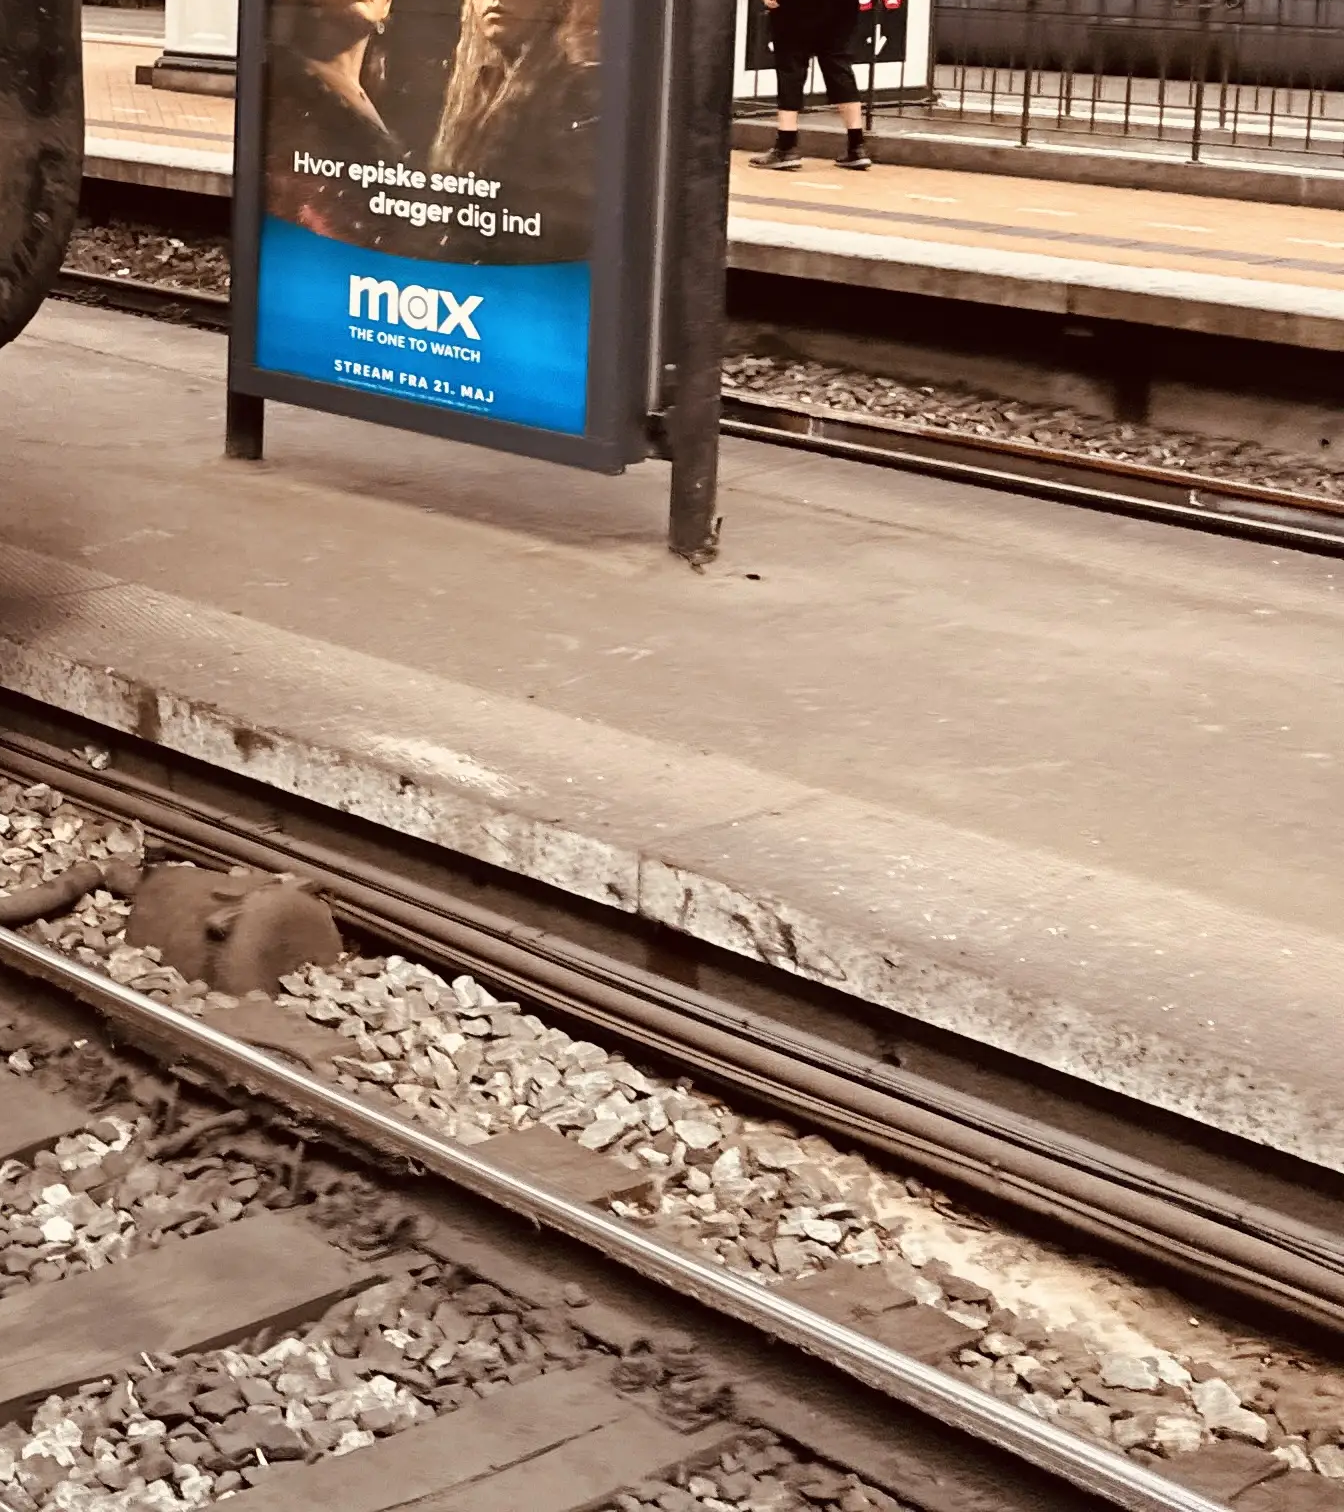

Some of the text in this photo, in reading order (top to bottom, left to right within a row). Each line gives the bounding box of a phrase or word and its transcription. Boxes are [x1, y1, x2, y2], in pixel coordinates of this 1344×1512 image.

[293, 150, 501, 199] Hvor episke serier
[369, 191, 541, 237] drager dig ind
[348, 274, 484, 341] max
[348, 325, 481, 364] THE ONE TO WATCH
[334, 359, 394, 383] STREAM
[399, 372, 428, 390] FRA
[433, 379, 456, 395] 21.
[460, 384, 494, 403] MAJ
